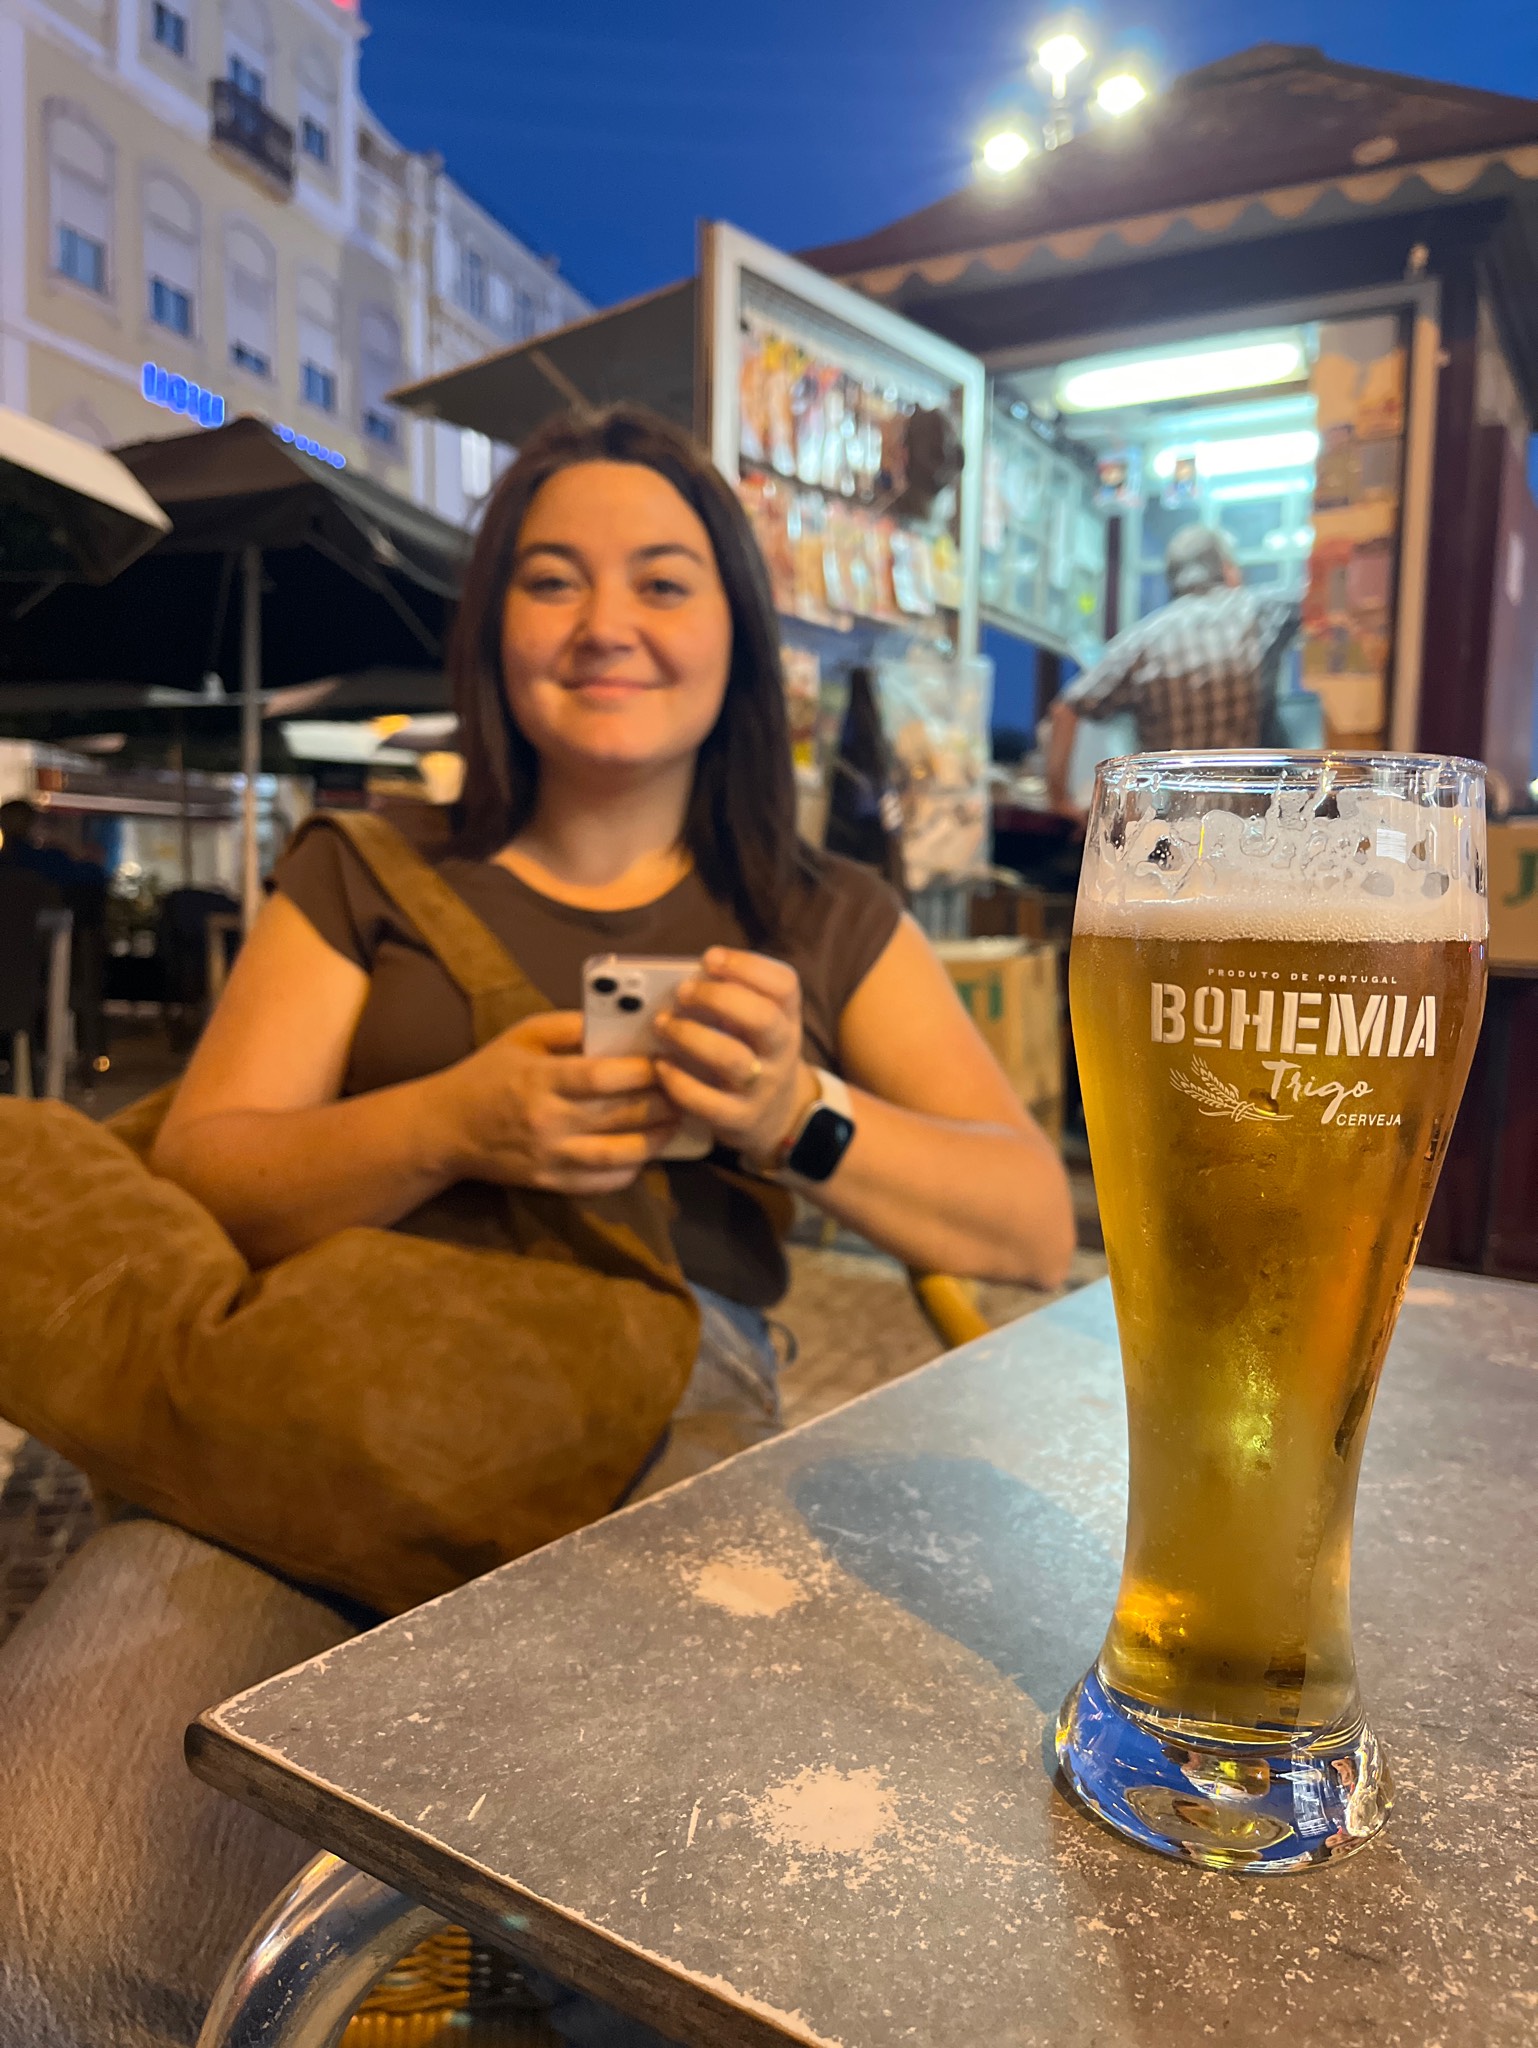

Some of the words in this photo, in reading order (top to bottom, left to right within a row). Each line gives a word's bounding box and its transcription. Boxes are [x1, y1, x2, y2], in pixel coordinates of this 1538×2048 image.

[1208, 968, 1280, 979] PRODUTO
[1290, 972, 1308, 981] DE
[1318, 973, 1397, 984] PORTUGAL
[1151, 982, 1436, 1057] BOHEMIA
[1261, 1059, 1374, 1124] Trigo
[1336, 1113, 1401, 1126] CERVEJA
